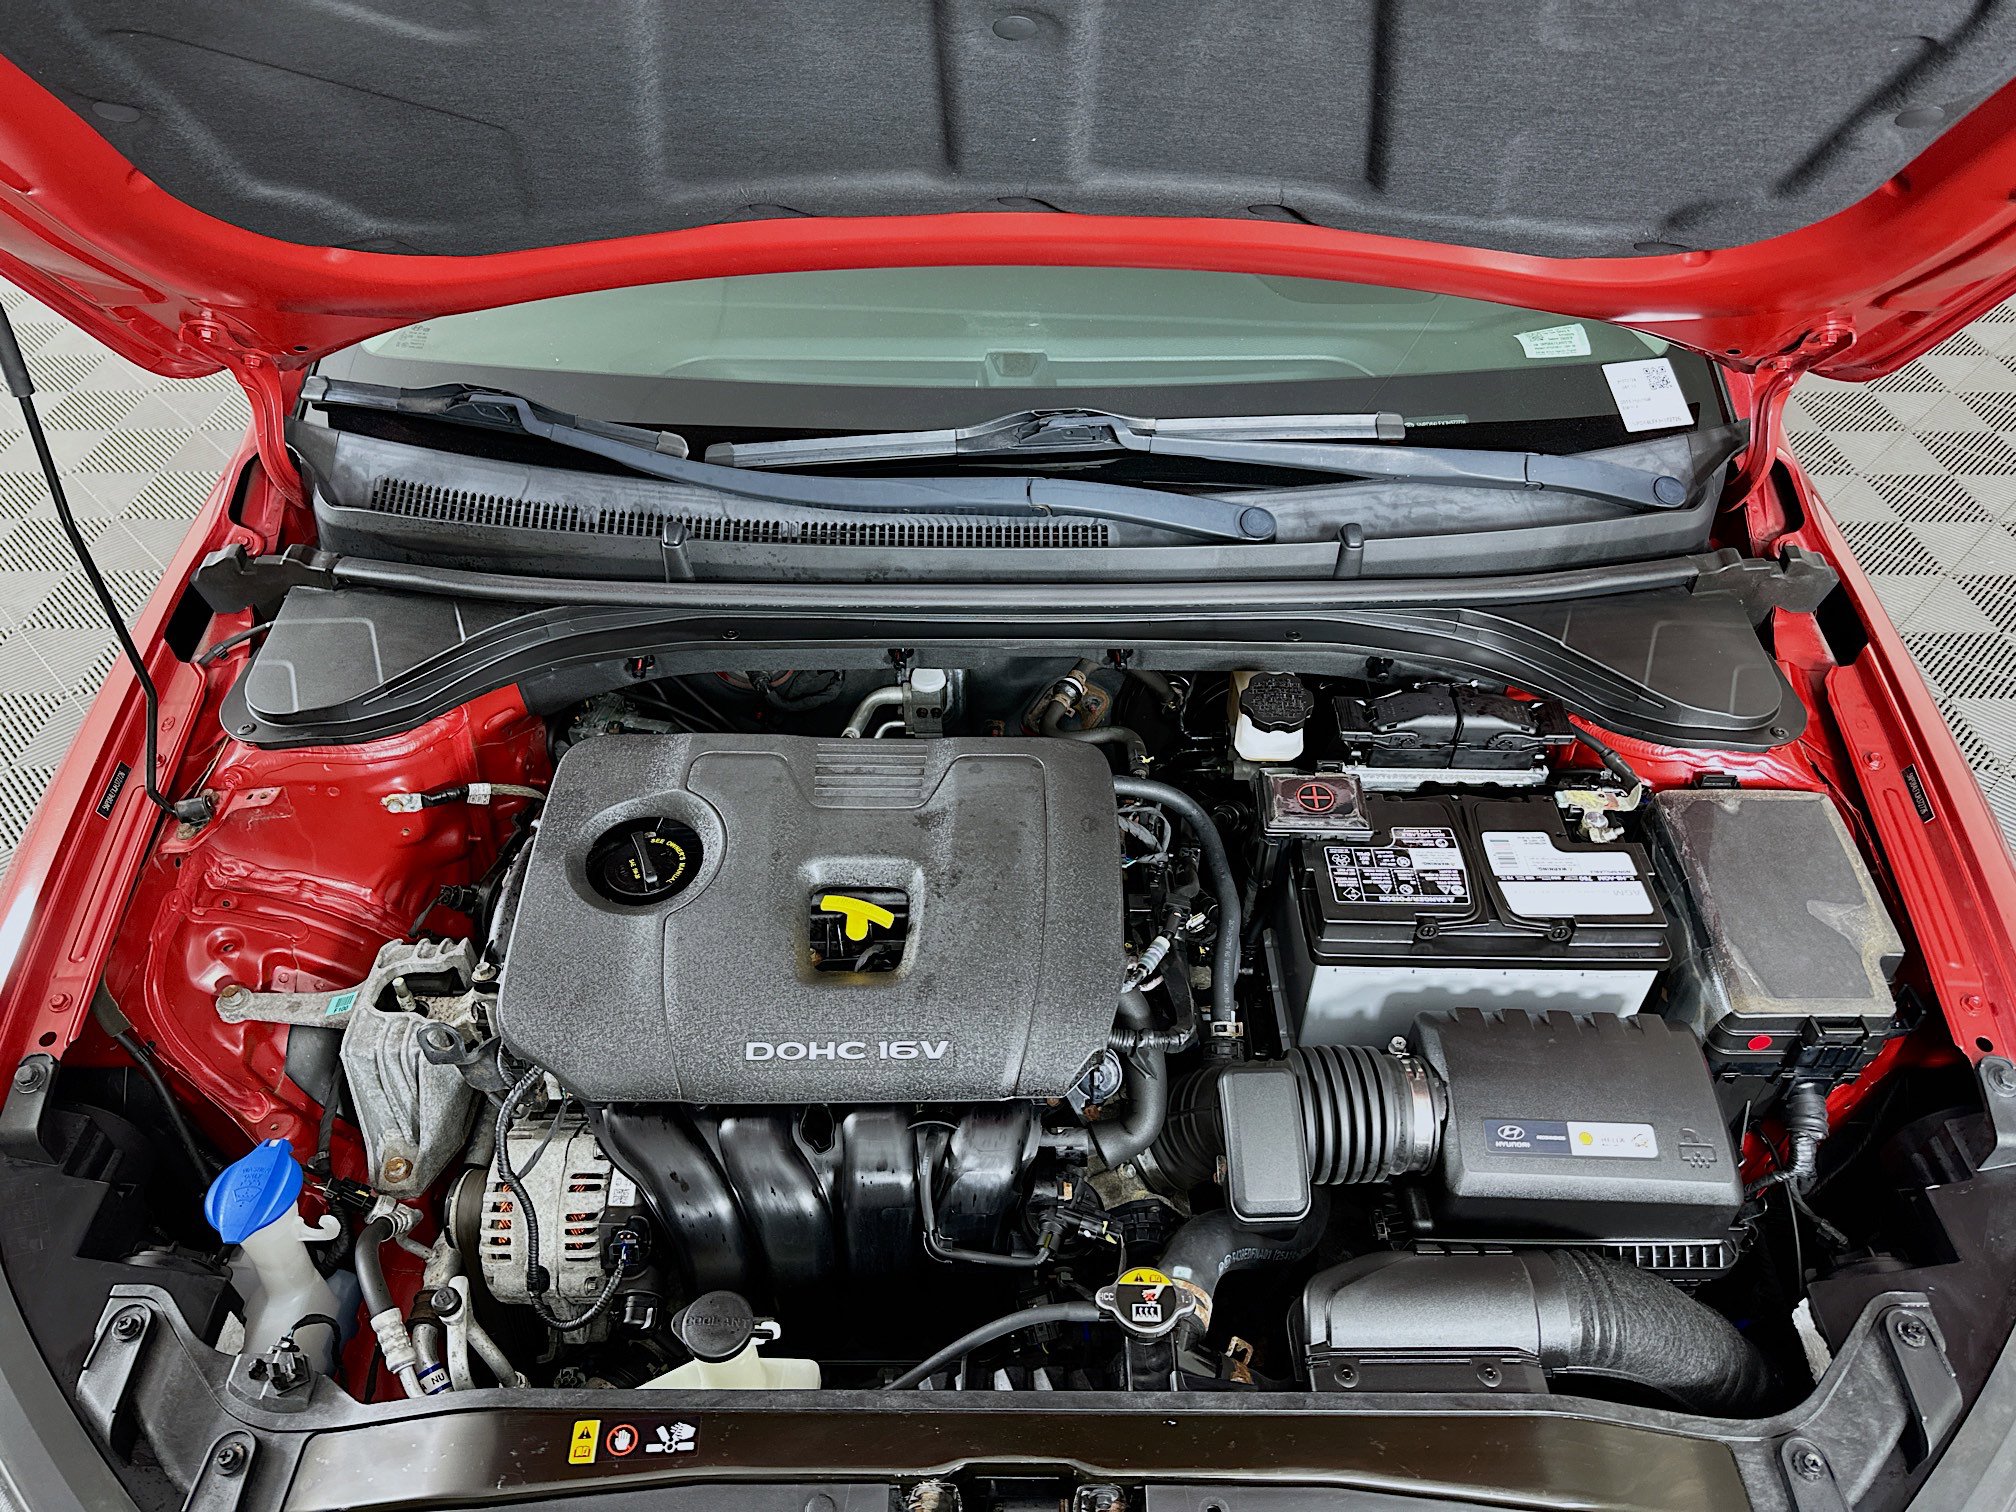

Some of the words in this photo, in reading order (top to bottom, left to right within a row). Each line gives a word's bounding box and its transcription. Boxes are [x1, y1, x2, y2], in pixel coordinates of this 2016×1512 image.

[745, 1041, 866, 1061] DOHC
[879, 1040, 949, 1060] 16V
[686, 1315, 751, 1329] COOLANT
[430, 1372, 445, 1385] NU
